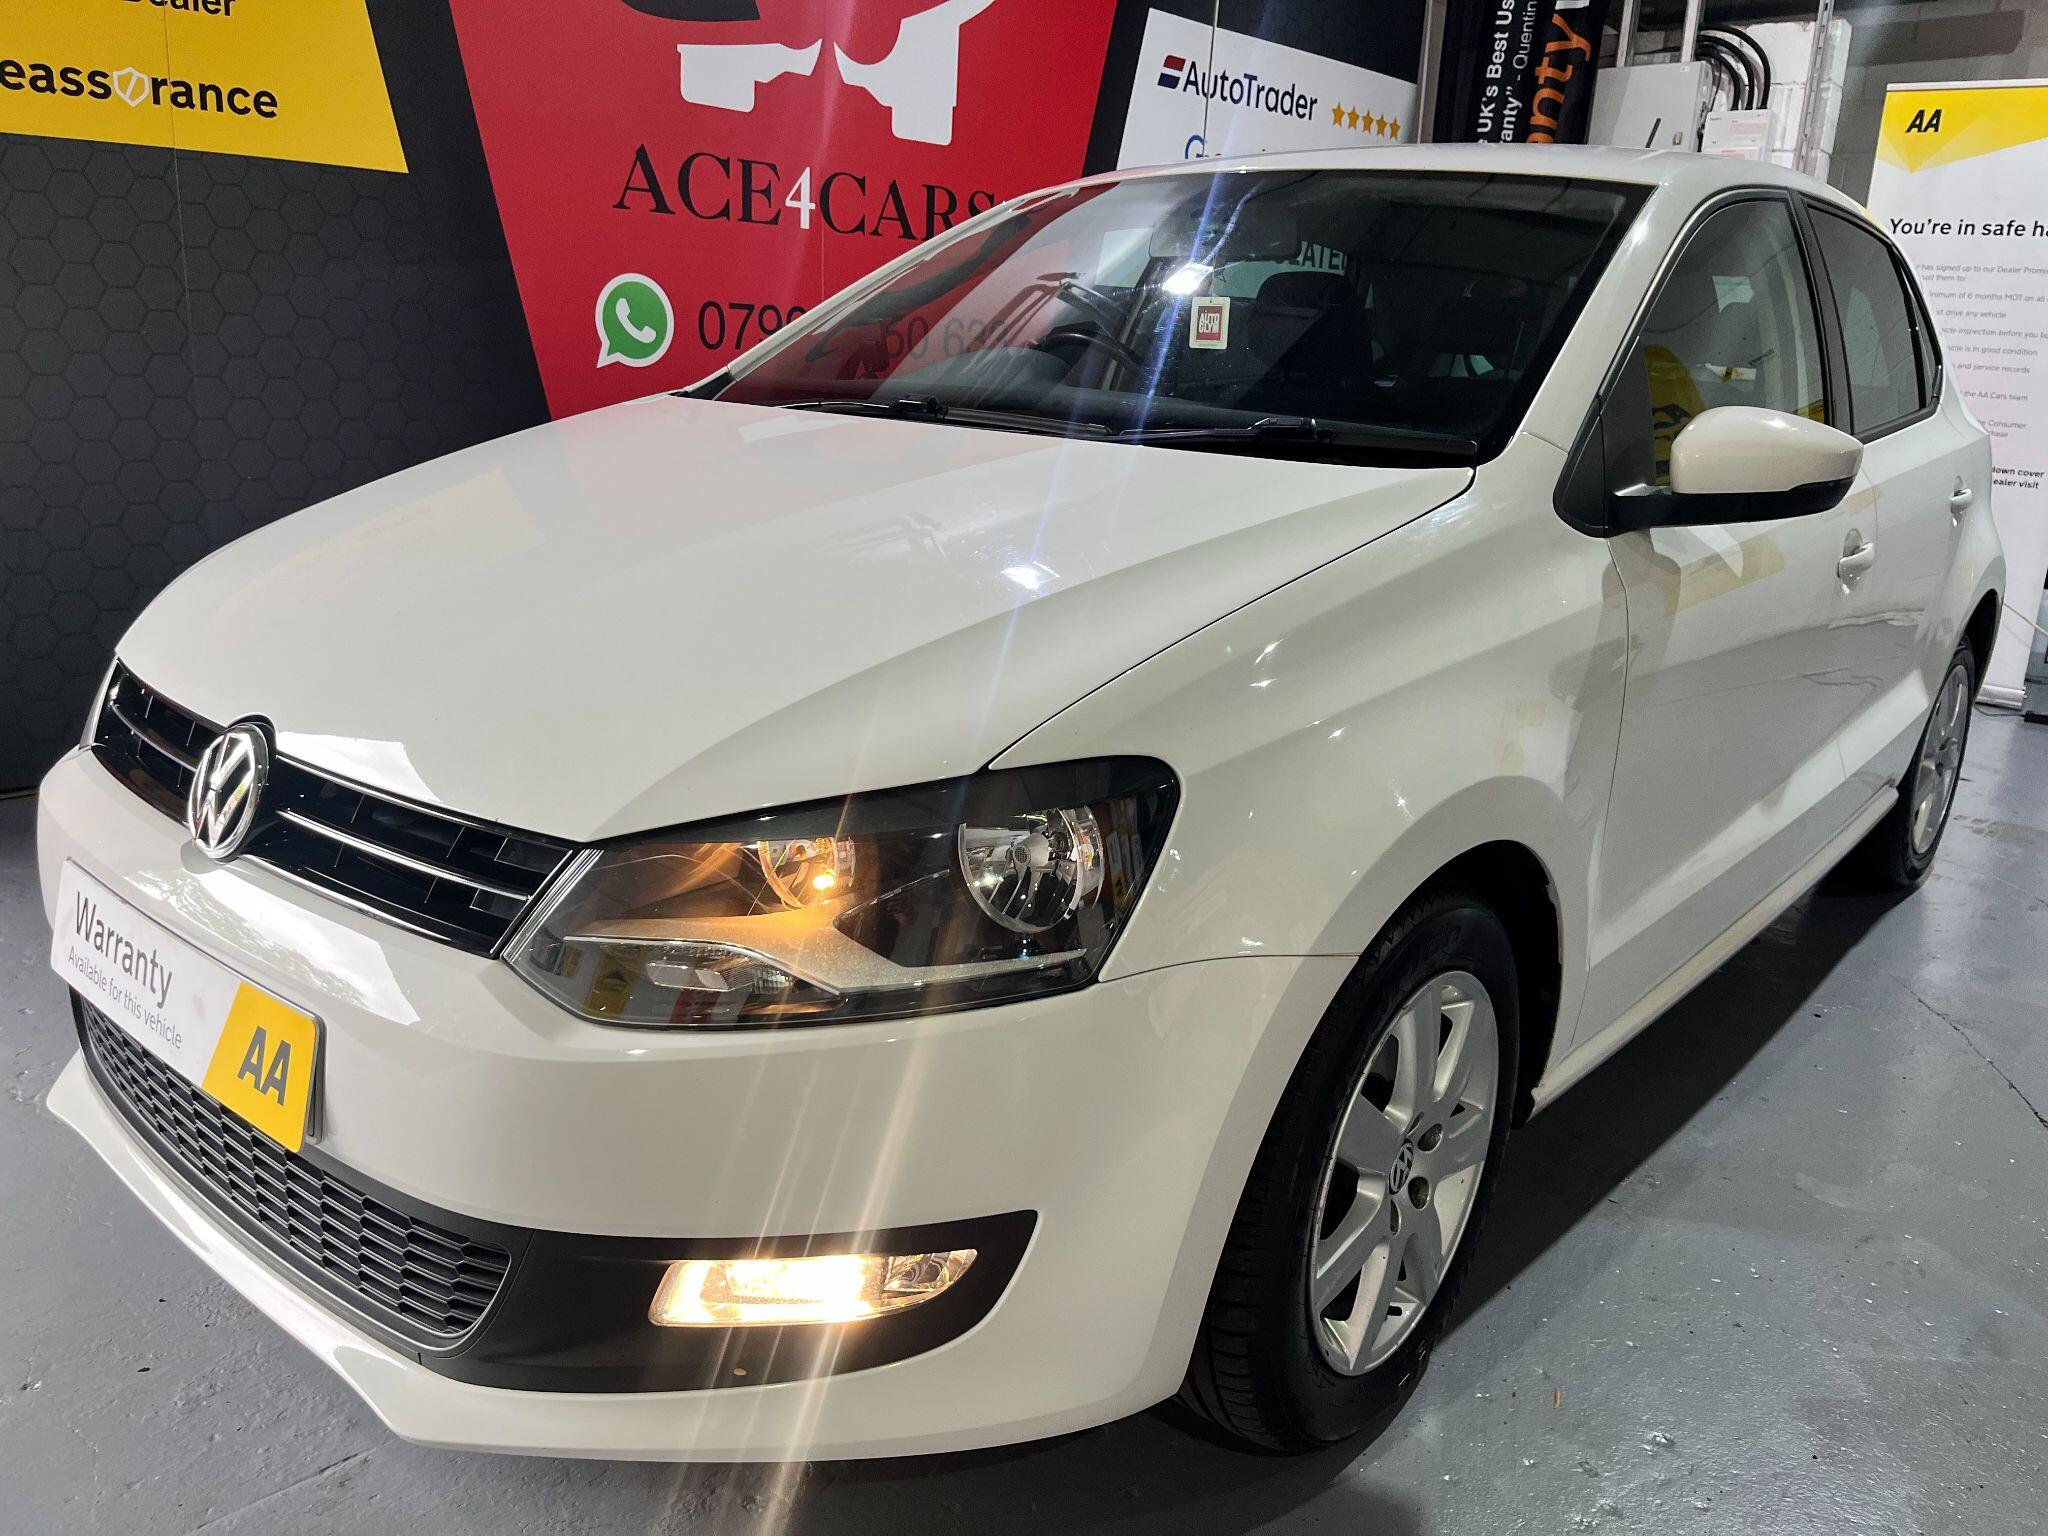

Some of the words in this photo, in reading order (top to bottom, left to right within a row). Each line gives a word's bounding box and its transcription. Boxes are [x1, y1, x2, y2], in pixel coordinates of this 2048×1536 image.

[122, 0, 236, 16] aer
[1486, 33, 1509, 79] Best
[1512, 0, 1538, 69] Quentin
[1183, 61, 1318, 121] AutoTrader
[1905, 109, 1943, 134] AA
[1957, 219, 1976, 236] in
[1981, 219, 2026, 237] safe
[2017, 468, 2045, 478] cover
[2019, 480, 2039, 489] visit
[76, 892, 173, 1009] Warranty
[68, 945, 108, 991] Available
[109, 977, 122, 1003] for
[124, 990, 142, 1019] this
[144, 1009, 182, 1049] vehicle
[237, 1025, 292, 1107] AA
